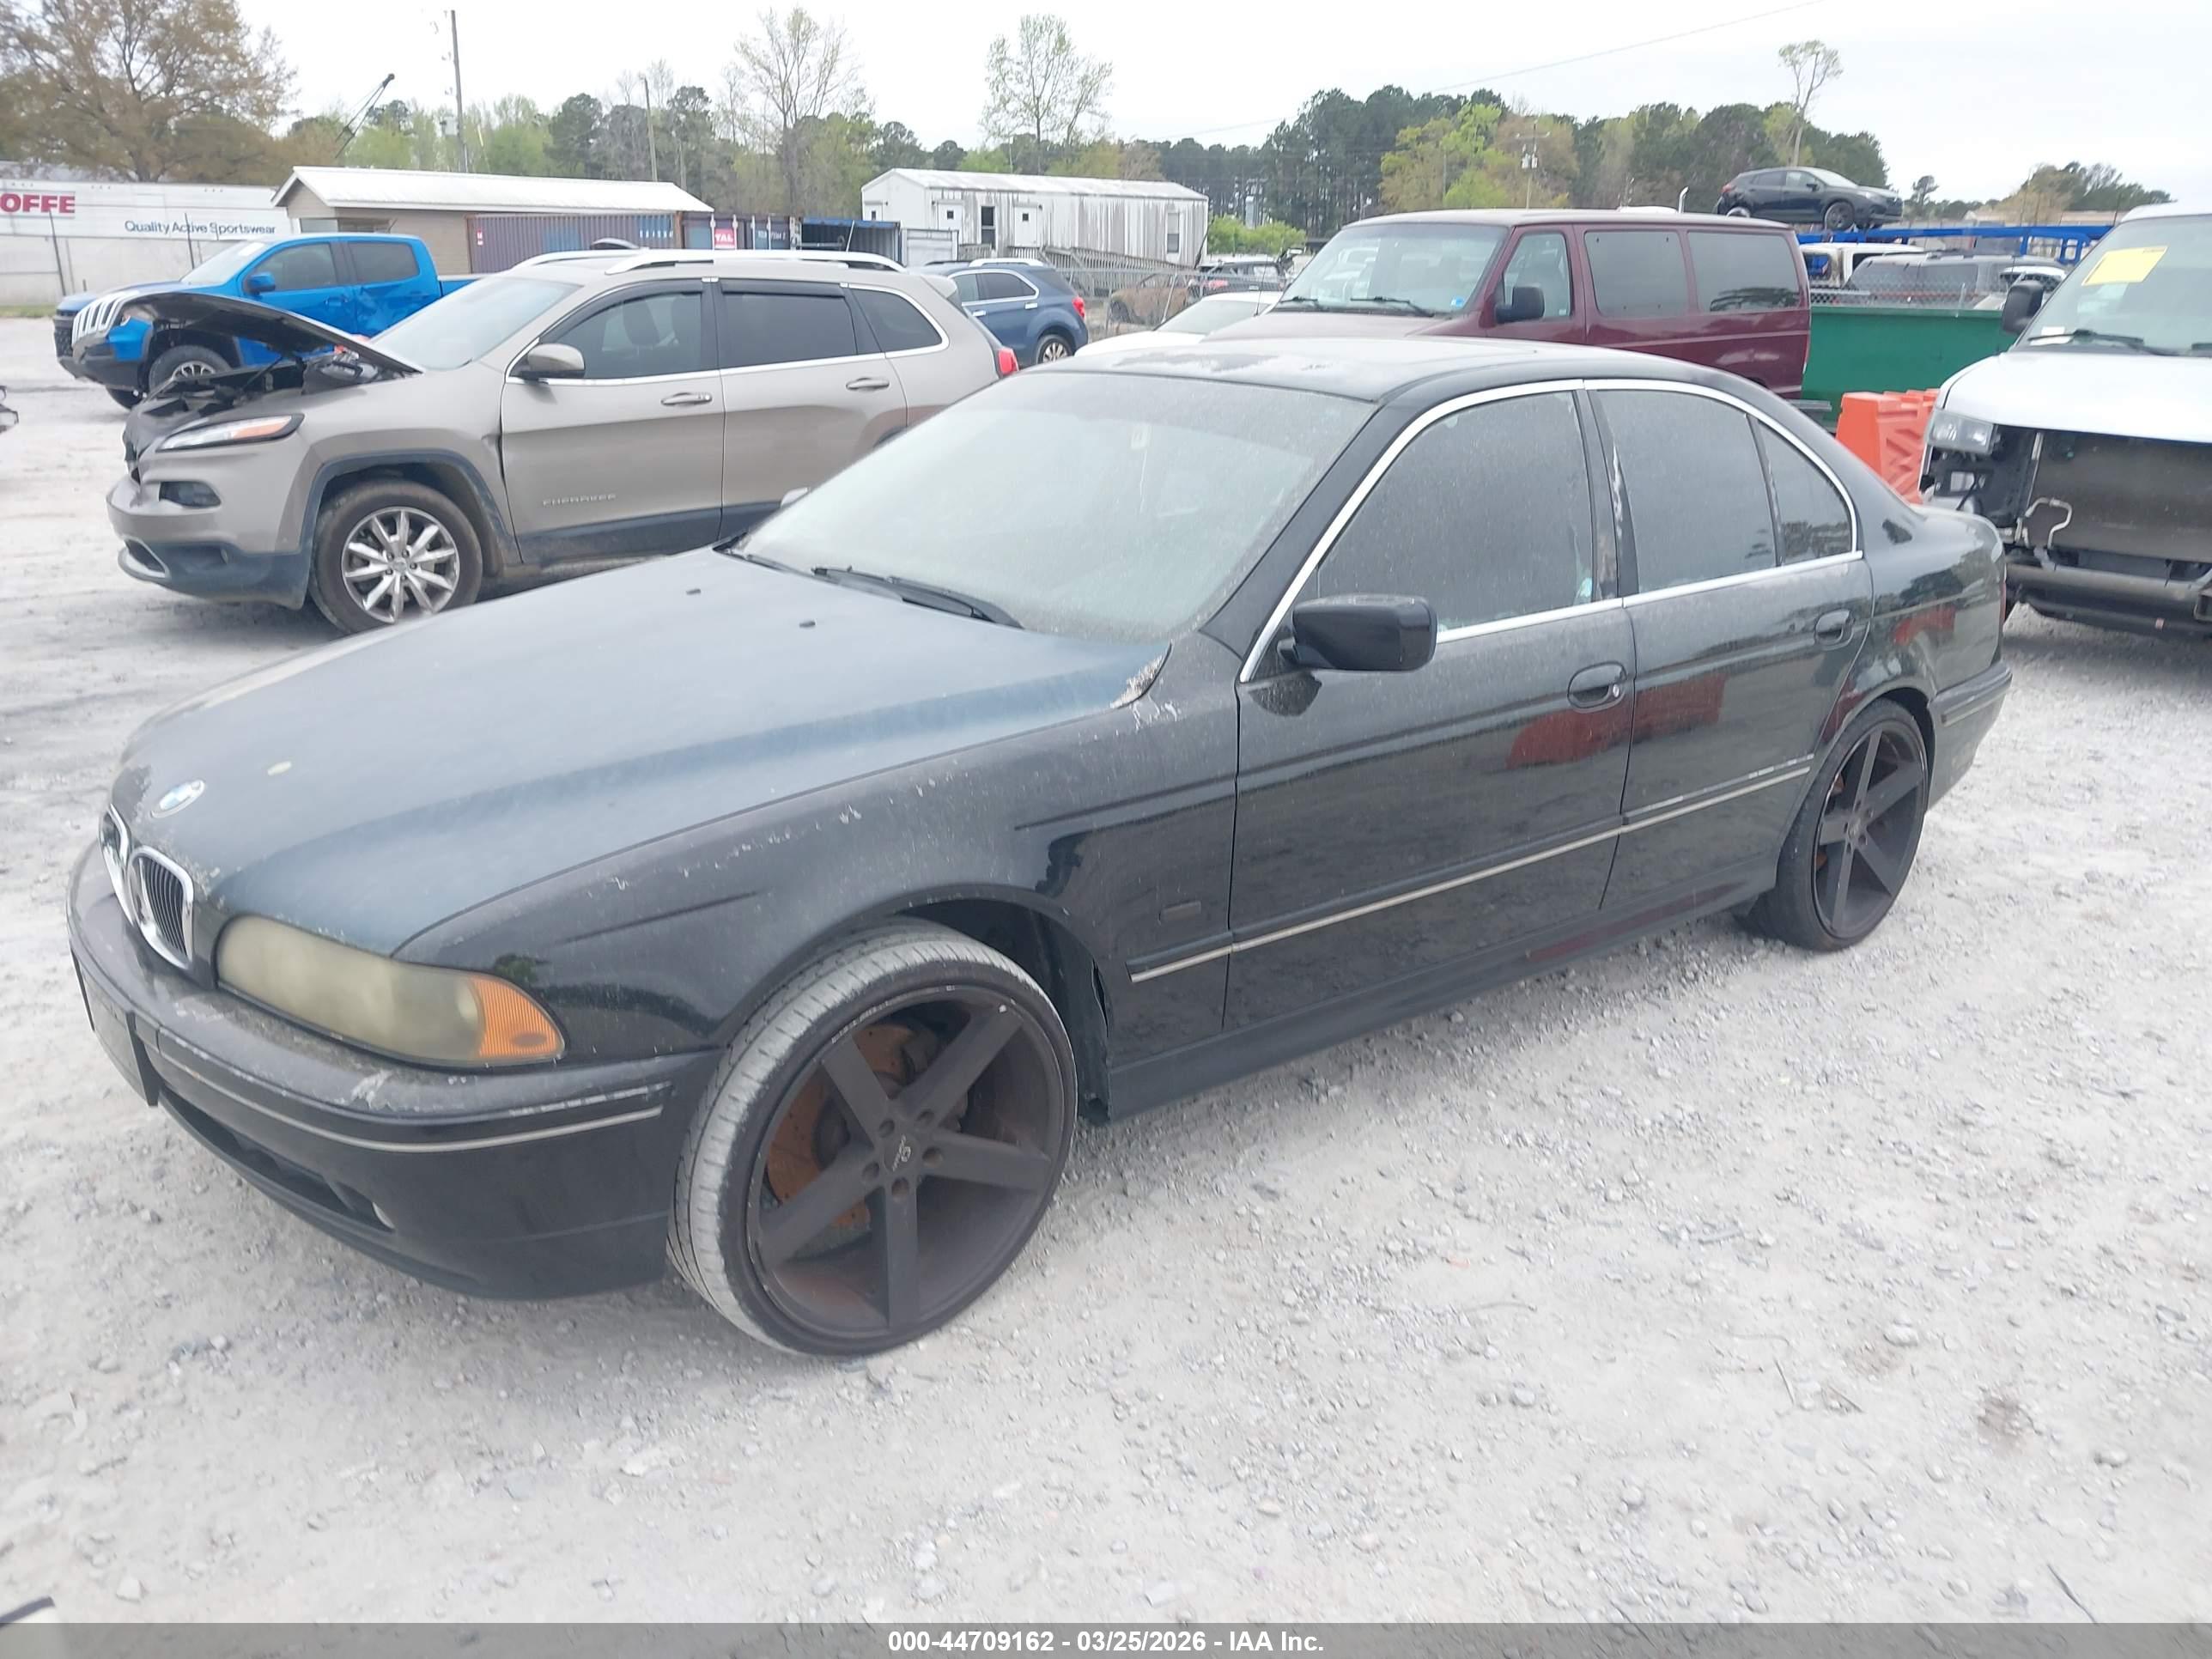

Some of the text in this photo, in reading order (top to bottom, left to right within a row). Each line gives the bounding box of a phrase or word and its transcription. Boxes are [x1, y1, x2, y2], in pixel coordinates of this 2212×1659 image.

[0, 192, 75, 214] OFFE
[125, 220, 276, 235] Quality Active Sportswear
